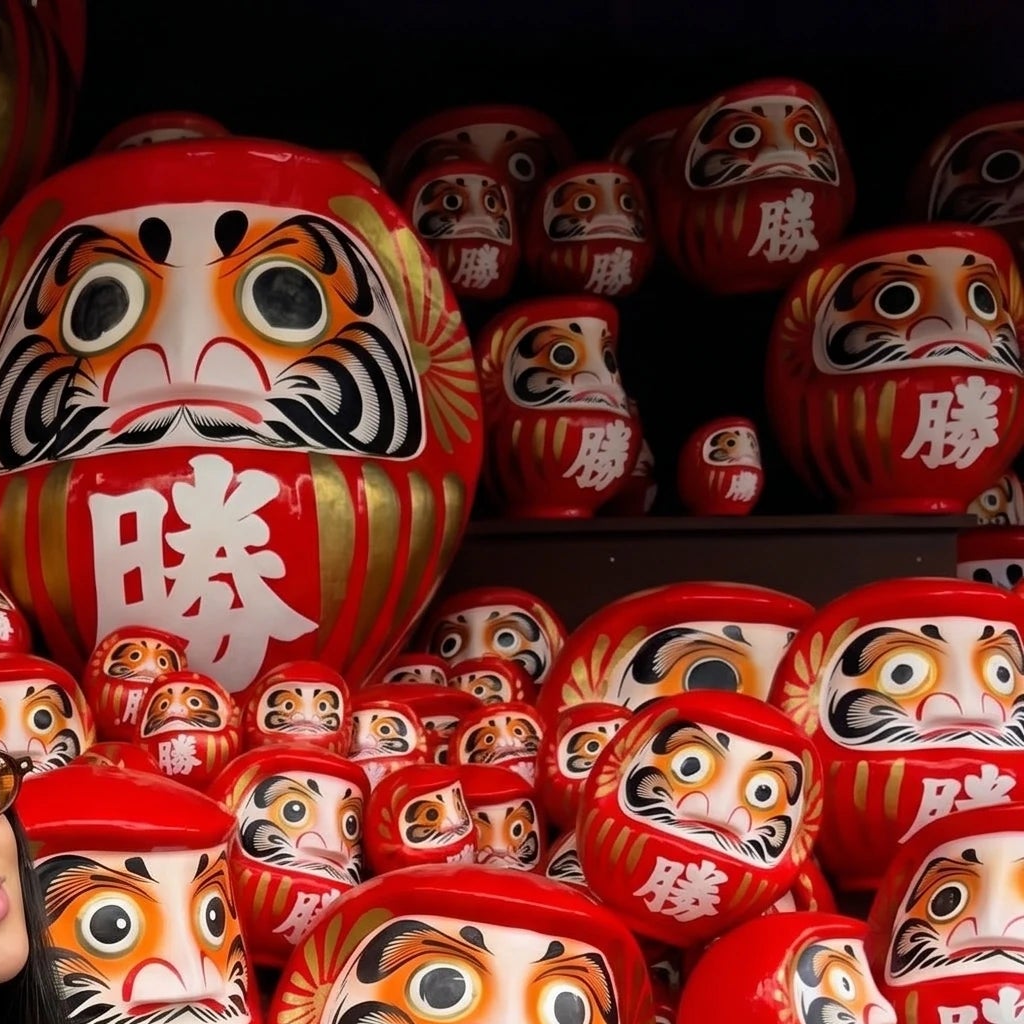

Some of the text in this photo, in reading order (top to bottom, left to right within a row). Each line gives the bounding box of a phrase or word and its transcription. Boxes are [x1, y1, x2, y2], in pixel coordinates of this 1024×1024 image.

[748, 188, 819, 263] 勝
[453, 243, 500, 288] 勝
[585, 247, 632, 295] 勝
[563, 420, 631, 484] 勝
[902, 376, 1001, 468] 勝
[88, 453, 319, 692] 勝
[158, 734, 202, 775] 勝
[632, 859, 728, 922] 勝
